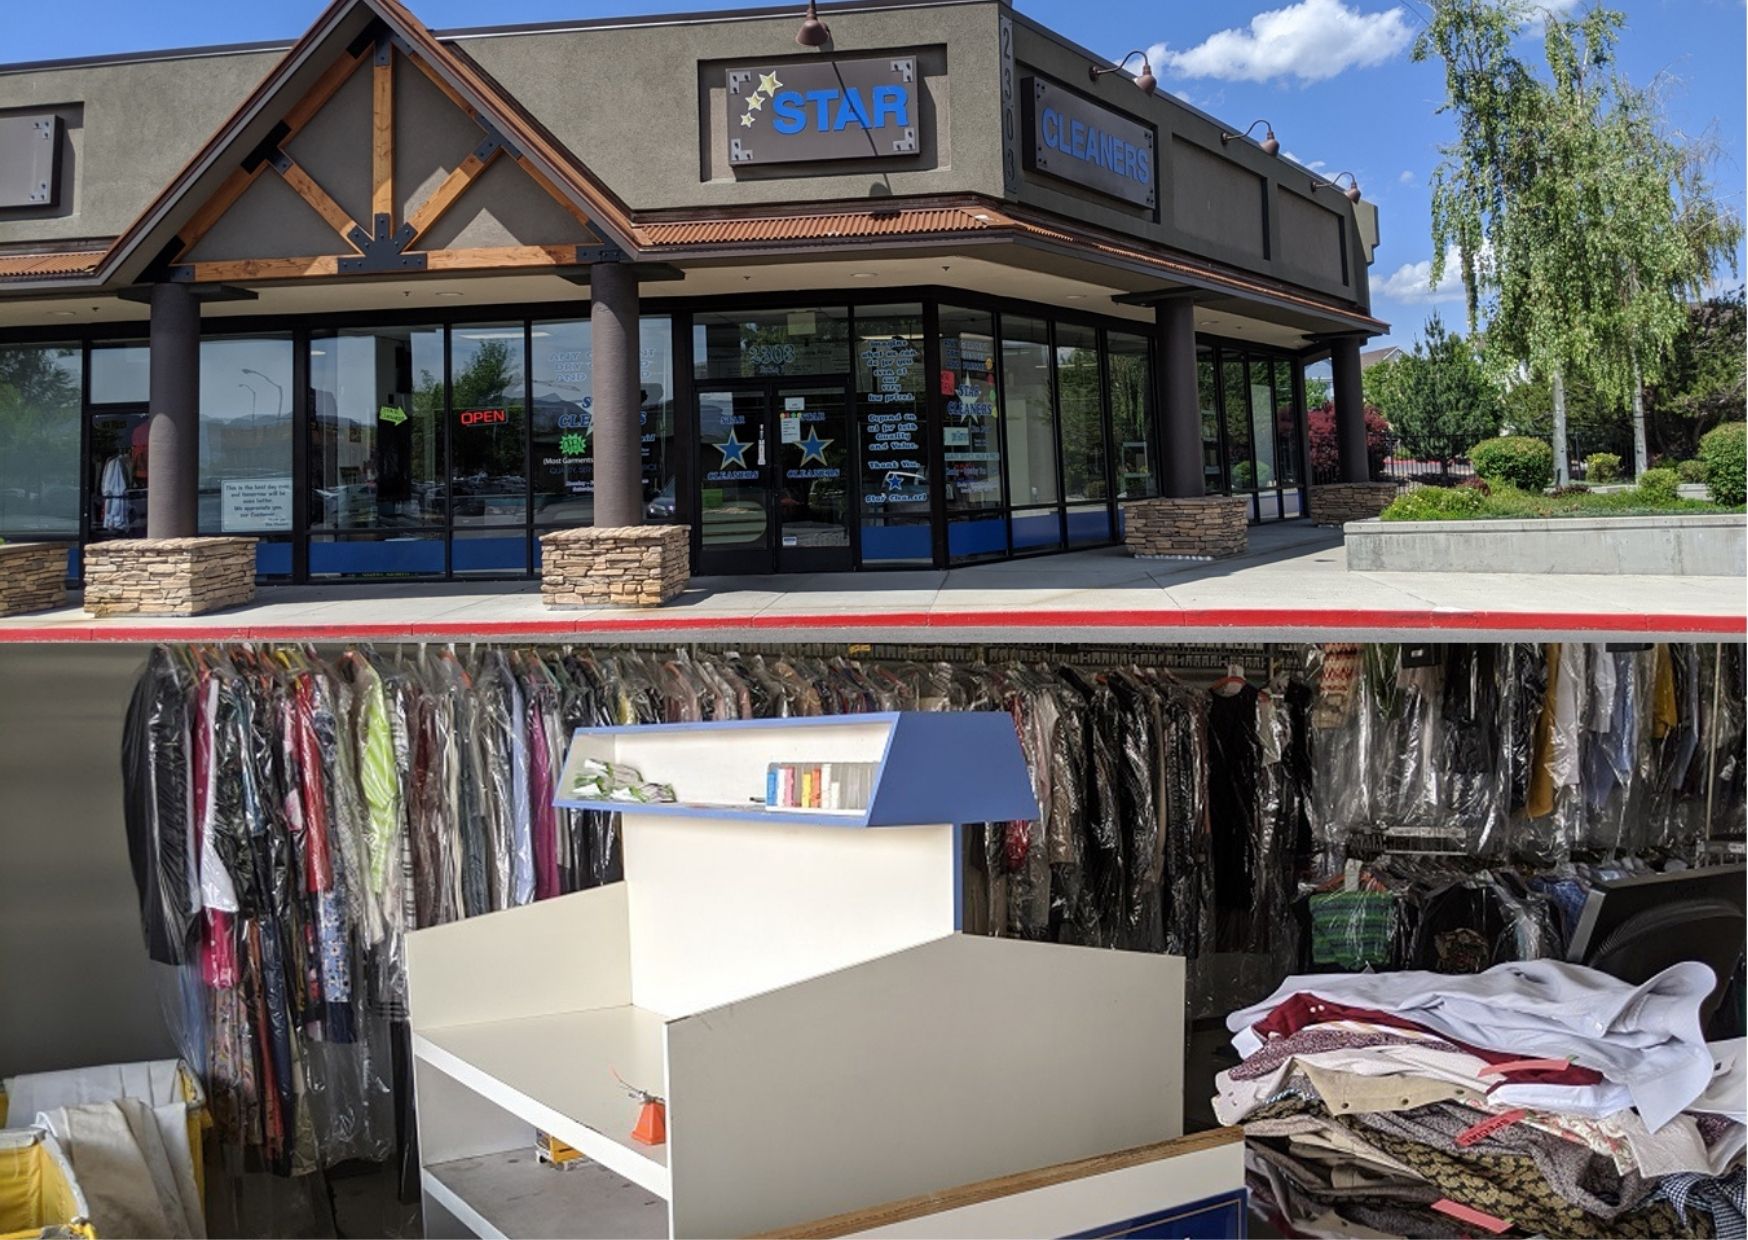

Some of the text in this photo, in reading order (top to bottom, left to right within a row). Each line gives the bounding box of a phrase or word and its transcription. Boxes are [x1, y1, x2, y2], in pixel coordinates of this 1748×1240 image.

[772, 84, 909, 135] STAR
[1002, 27, 1016, 182] 2303
[1041, 107, 1149, 185] CLEANERS
[461, 409, 505, 425] OPEN
[947, 400, 993, 416] CLEANERS
[542, 457, 562, 466] (Most
